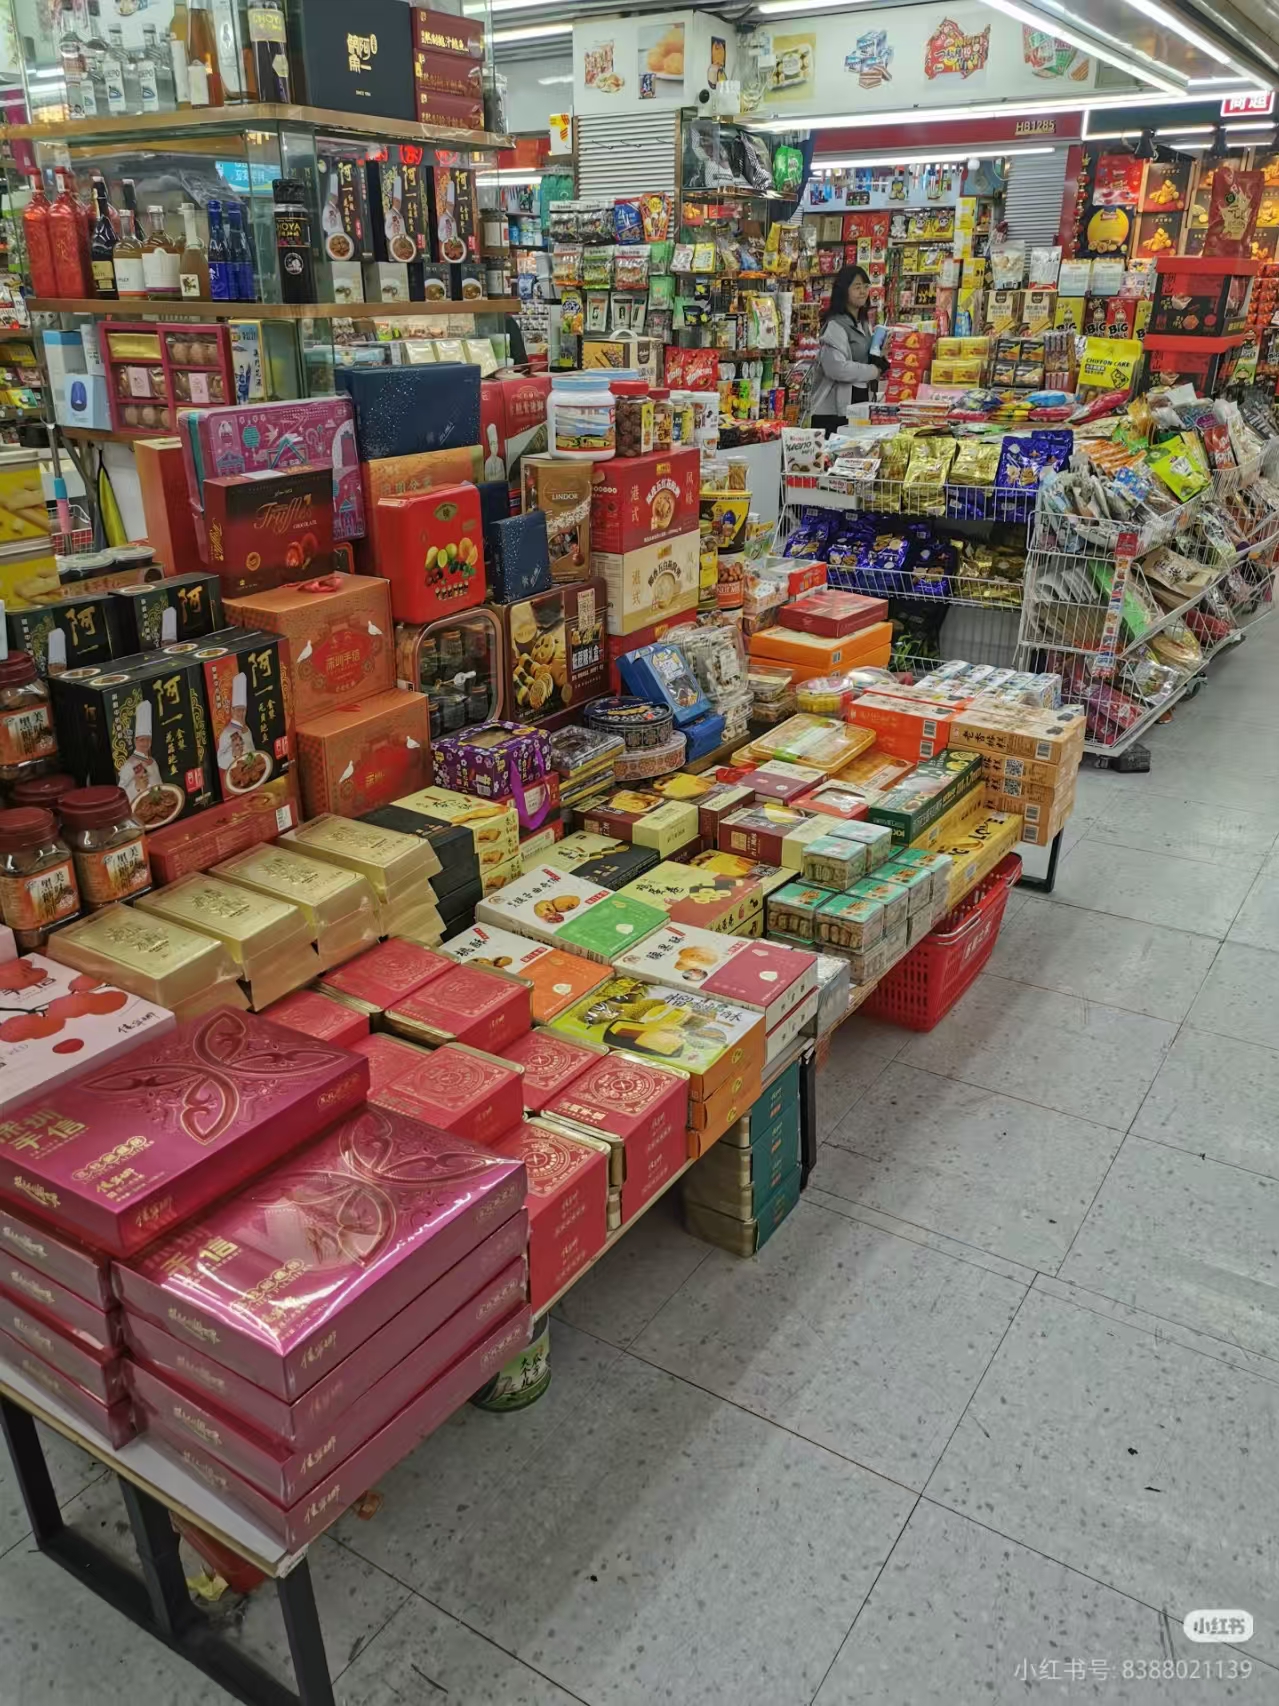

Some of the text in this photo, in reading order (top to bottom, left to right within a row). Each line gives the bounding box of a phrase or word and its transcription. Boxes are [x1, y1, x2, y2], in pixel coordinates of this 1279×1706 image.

[1088, 322, 1107, 334] BIG
[1108, 322, 1128, 335] BIG
[1086, 358, 1113, 366] CHIFFON
[551, 492, 578, 501] LINDOR
[248, 648, 274, 697] 阿一
[153, 675, 184, 726] 阿一
[8, 1118, 87, 1151] 手信
